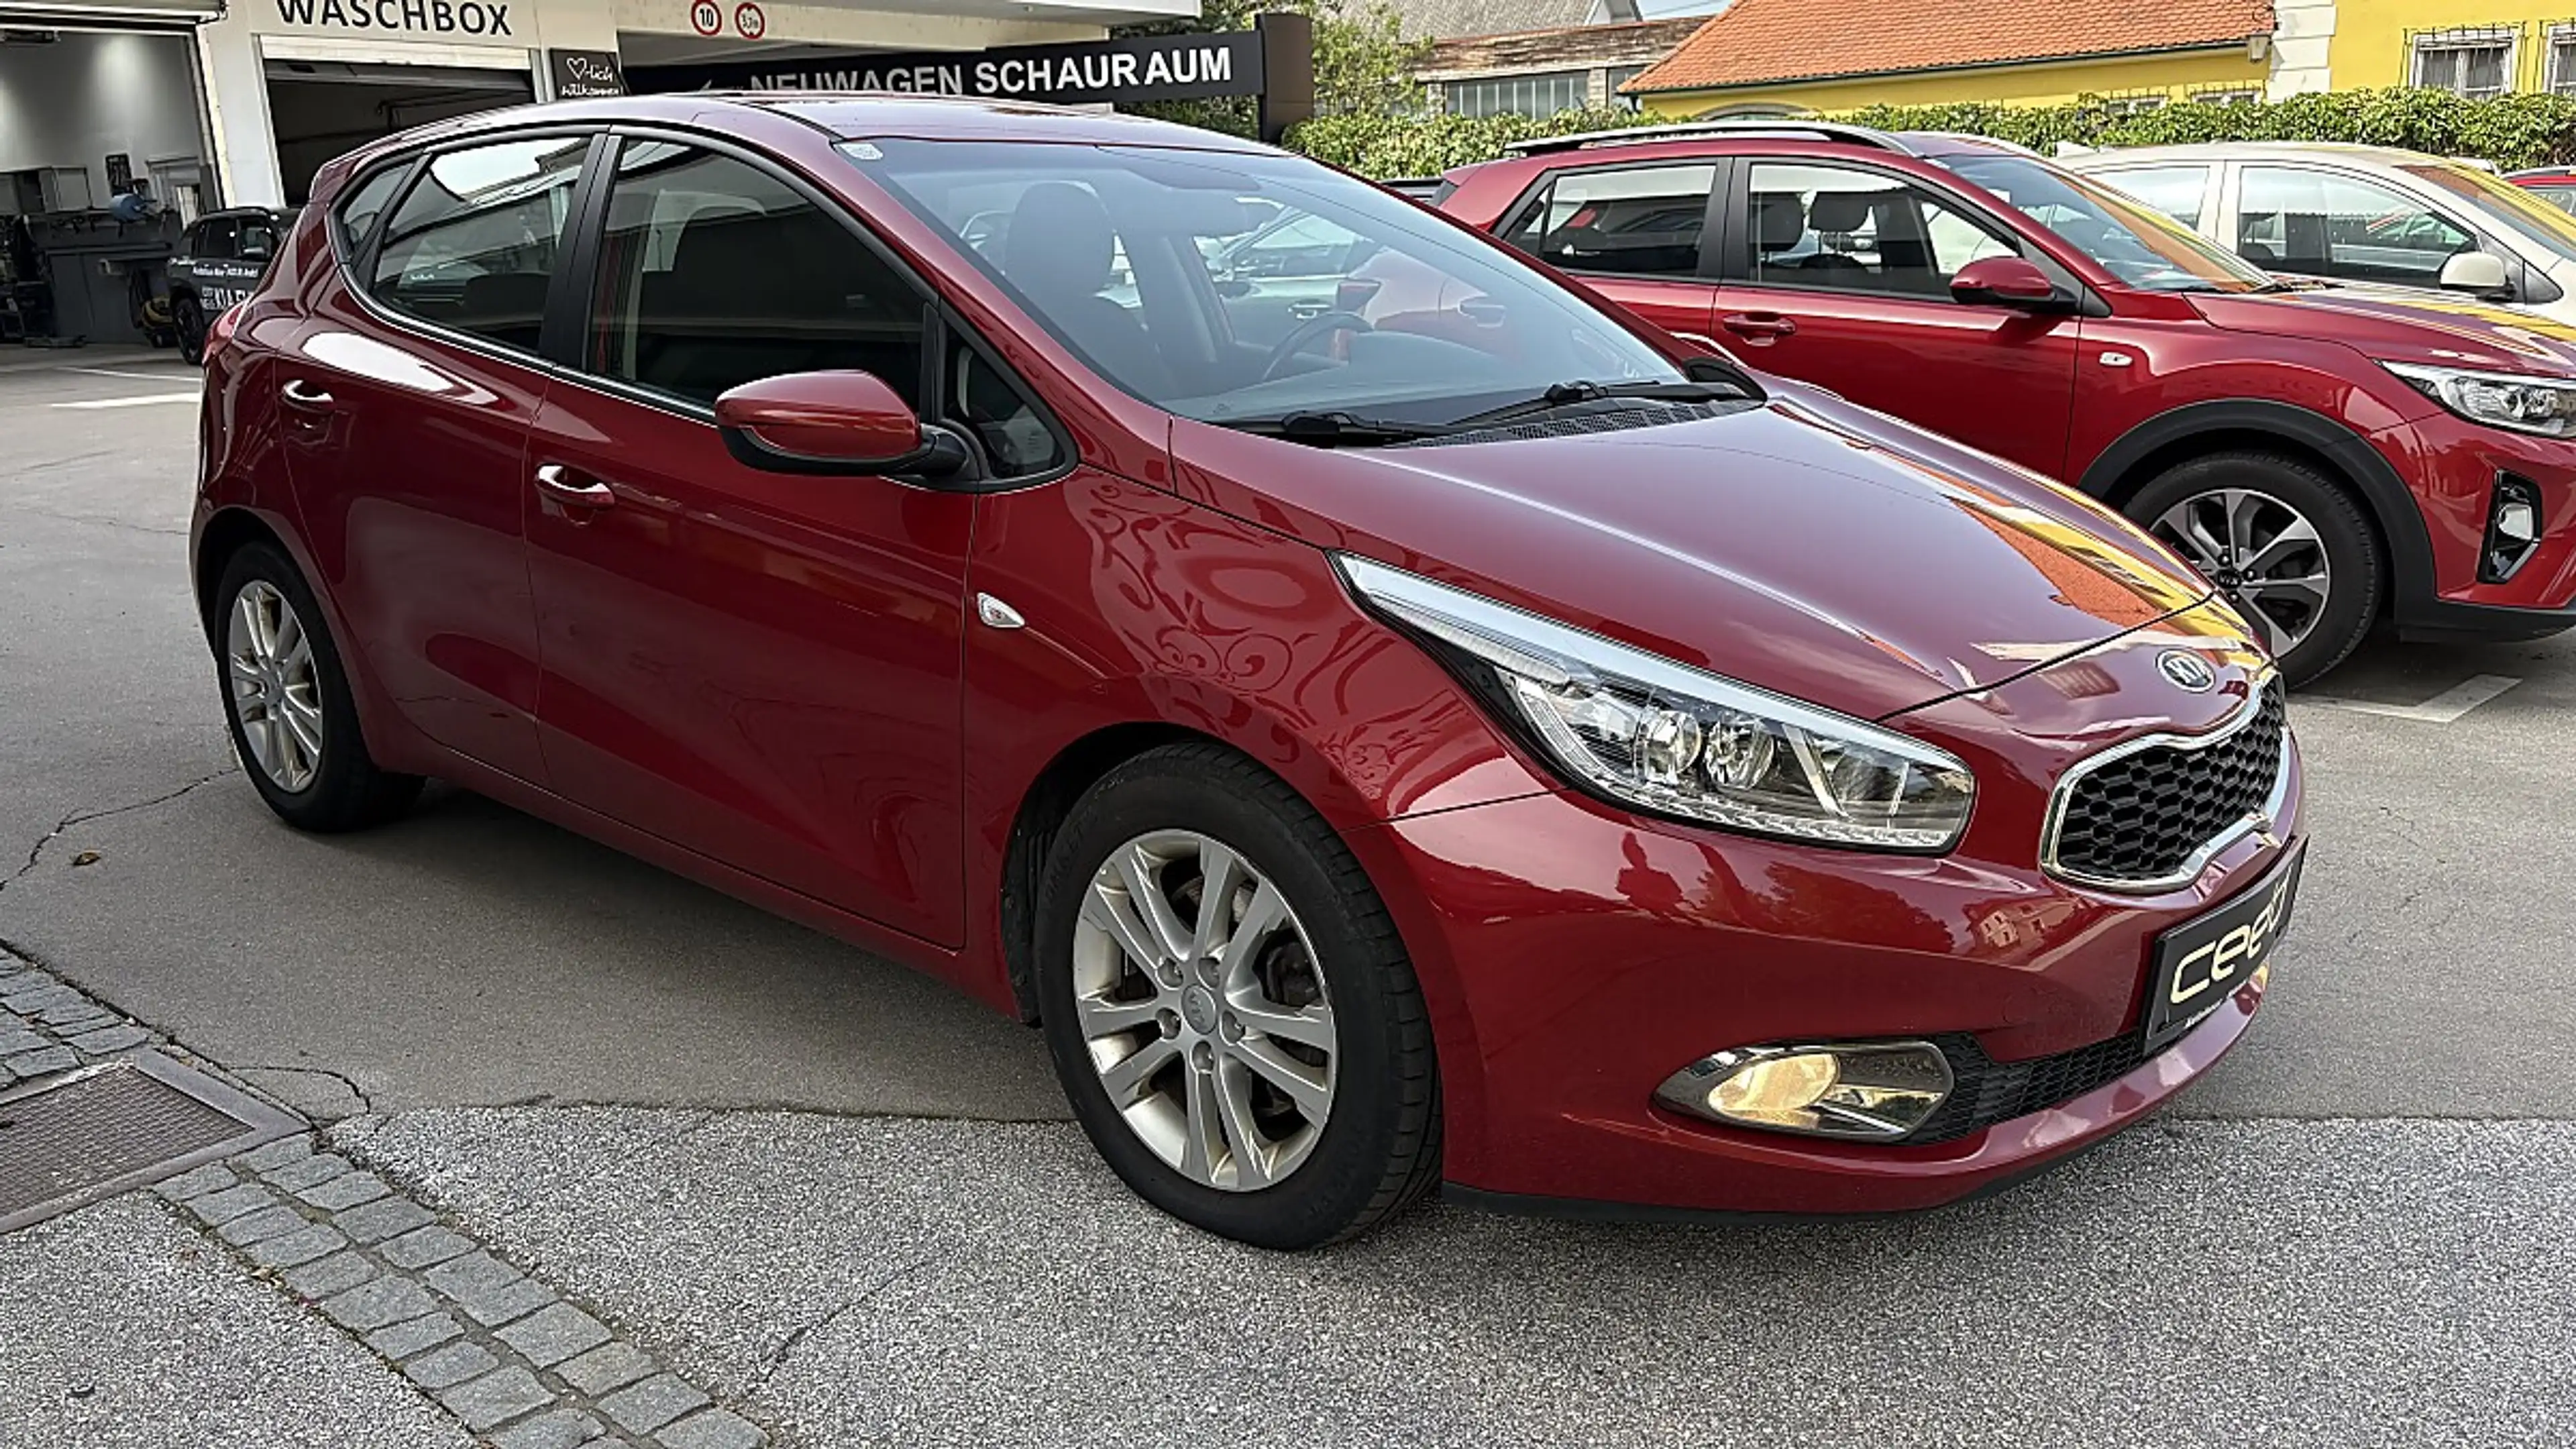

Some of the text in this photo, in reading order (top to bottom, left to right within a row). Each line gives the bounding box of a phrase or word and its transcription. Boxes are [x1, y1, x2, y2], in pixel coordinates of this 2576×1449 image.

[276, 0, 512, 36] WASCHBOX
[699, 8, 714, 27] 10
[975, 46, 1232, 94] SCHAURAUM
